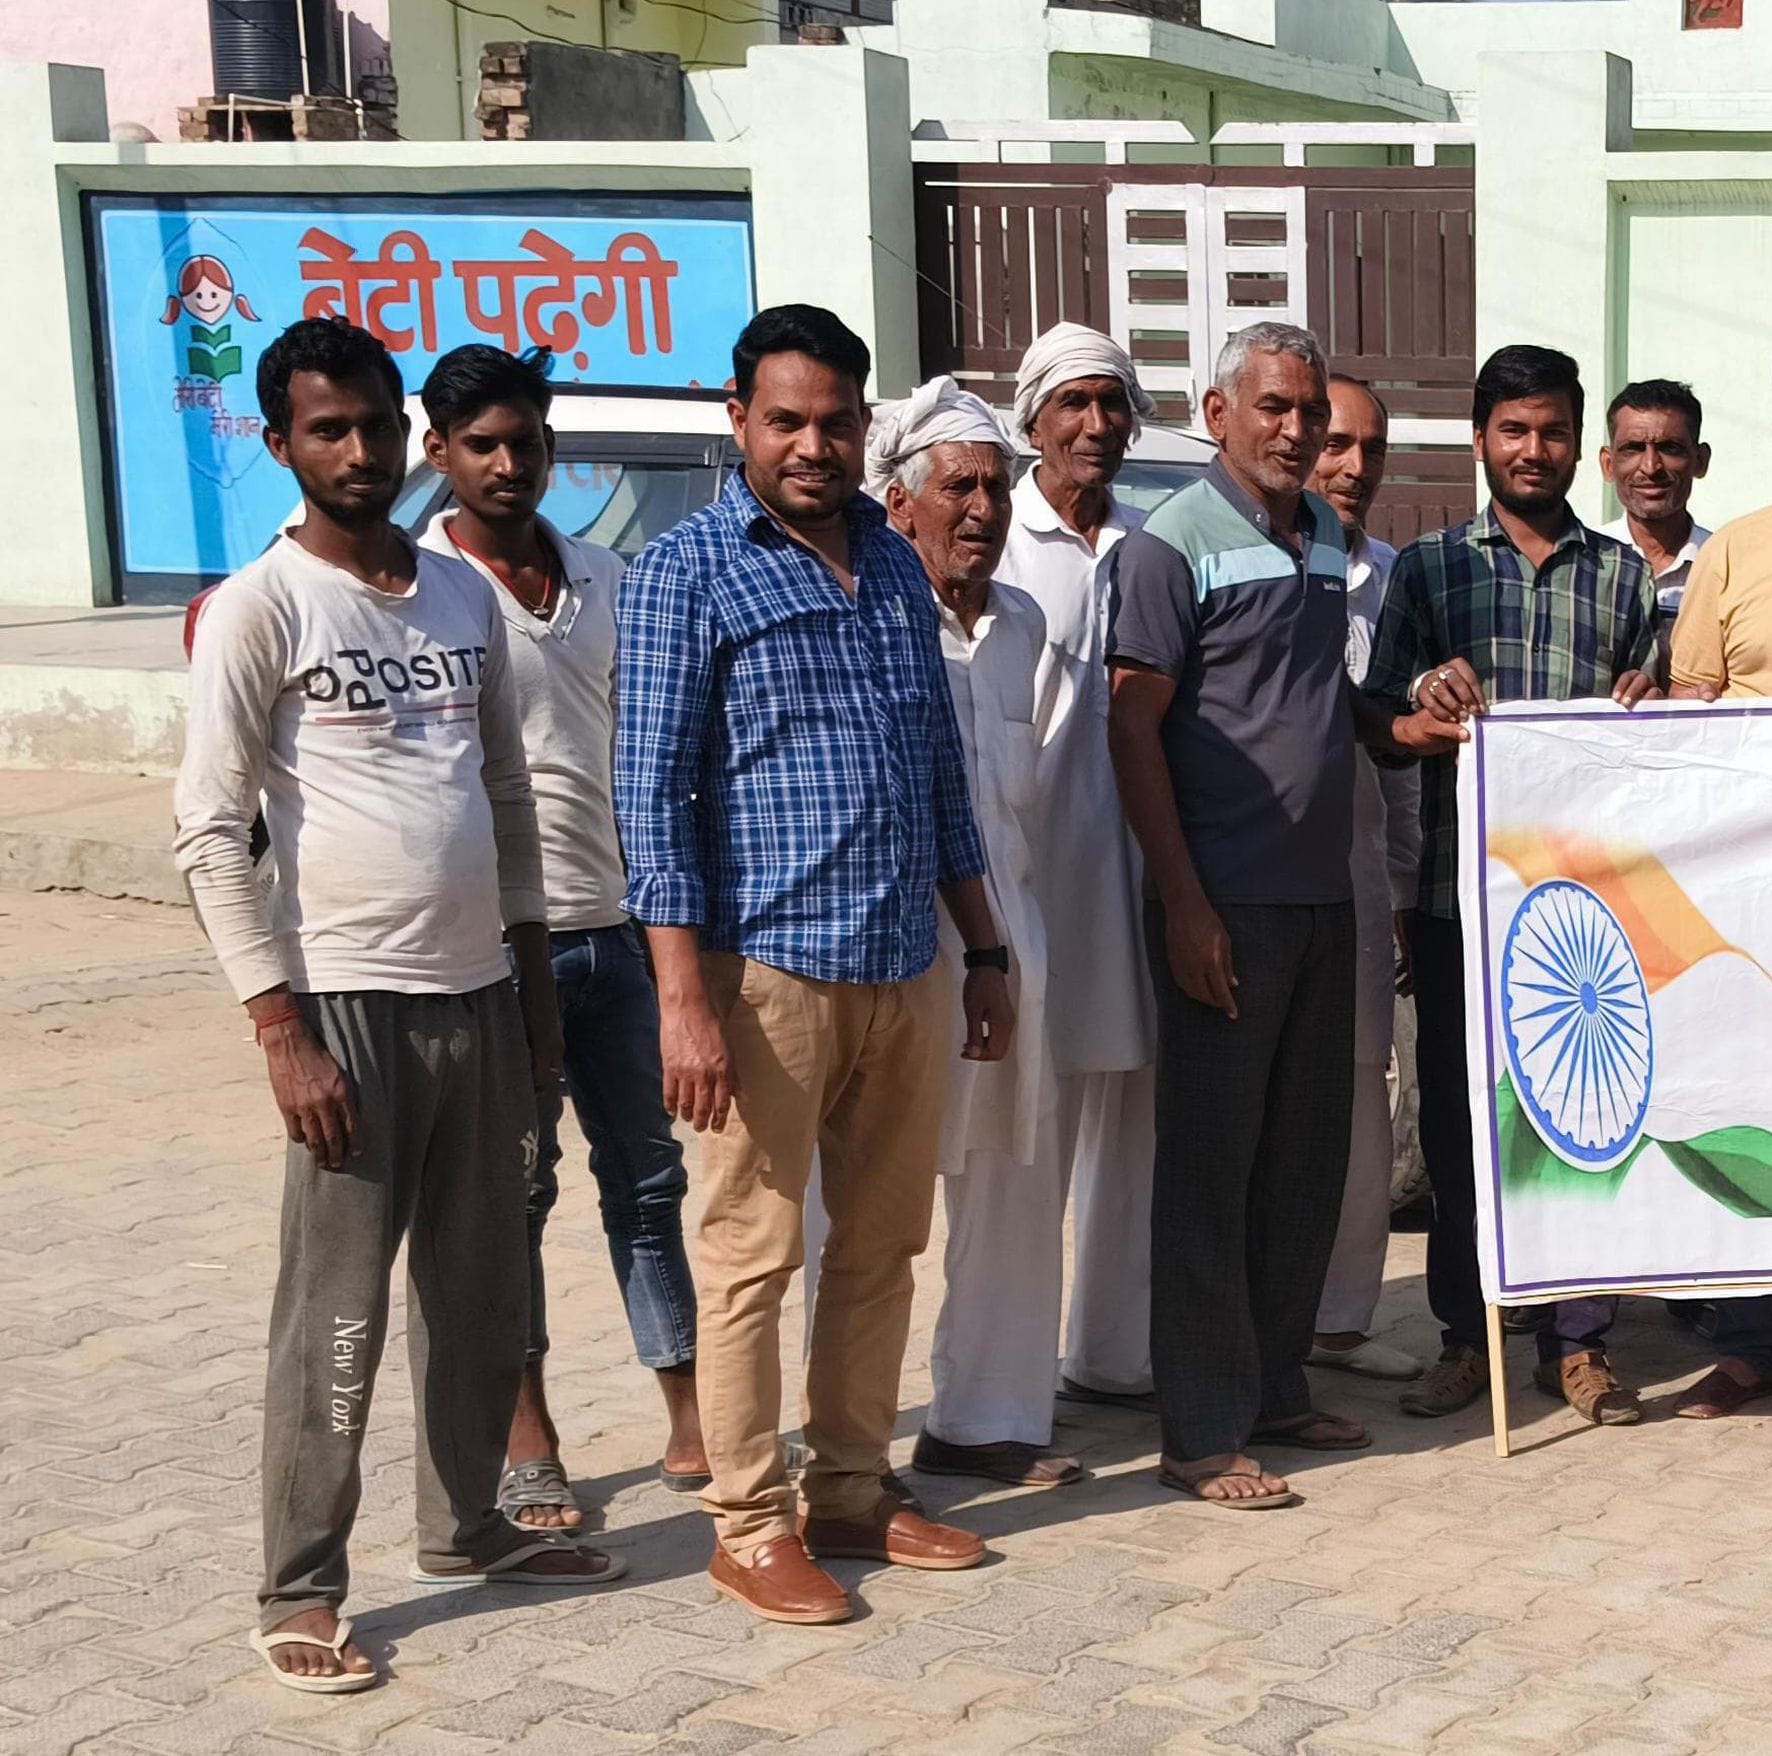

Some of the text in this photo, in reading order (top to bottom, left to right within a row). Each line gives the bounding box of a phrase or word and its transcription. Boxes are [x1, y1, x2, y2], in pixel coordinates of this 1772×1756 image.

[298, 227, 678, 371] बेटी पढ़ेगी
[331, 1316, 368, 1436] New York
